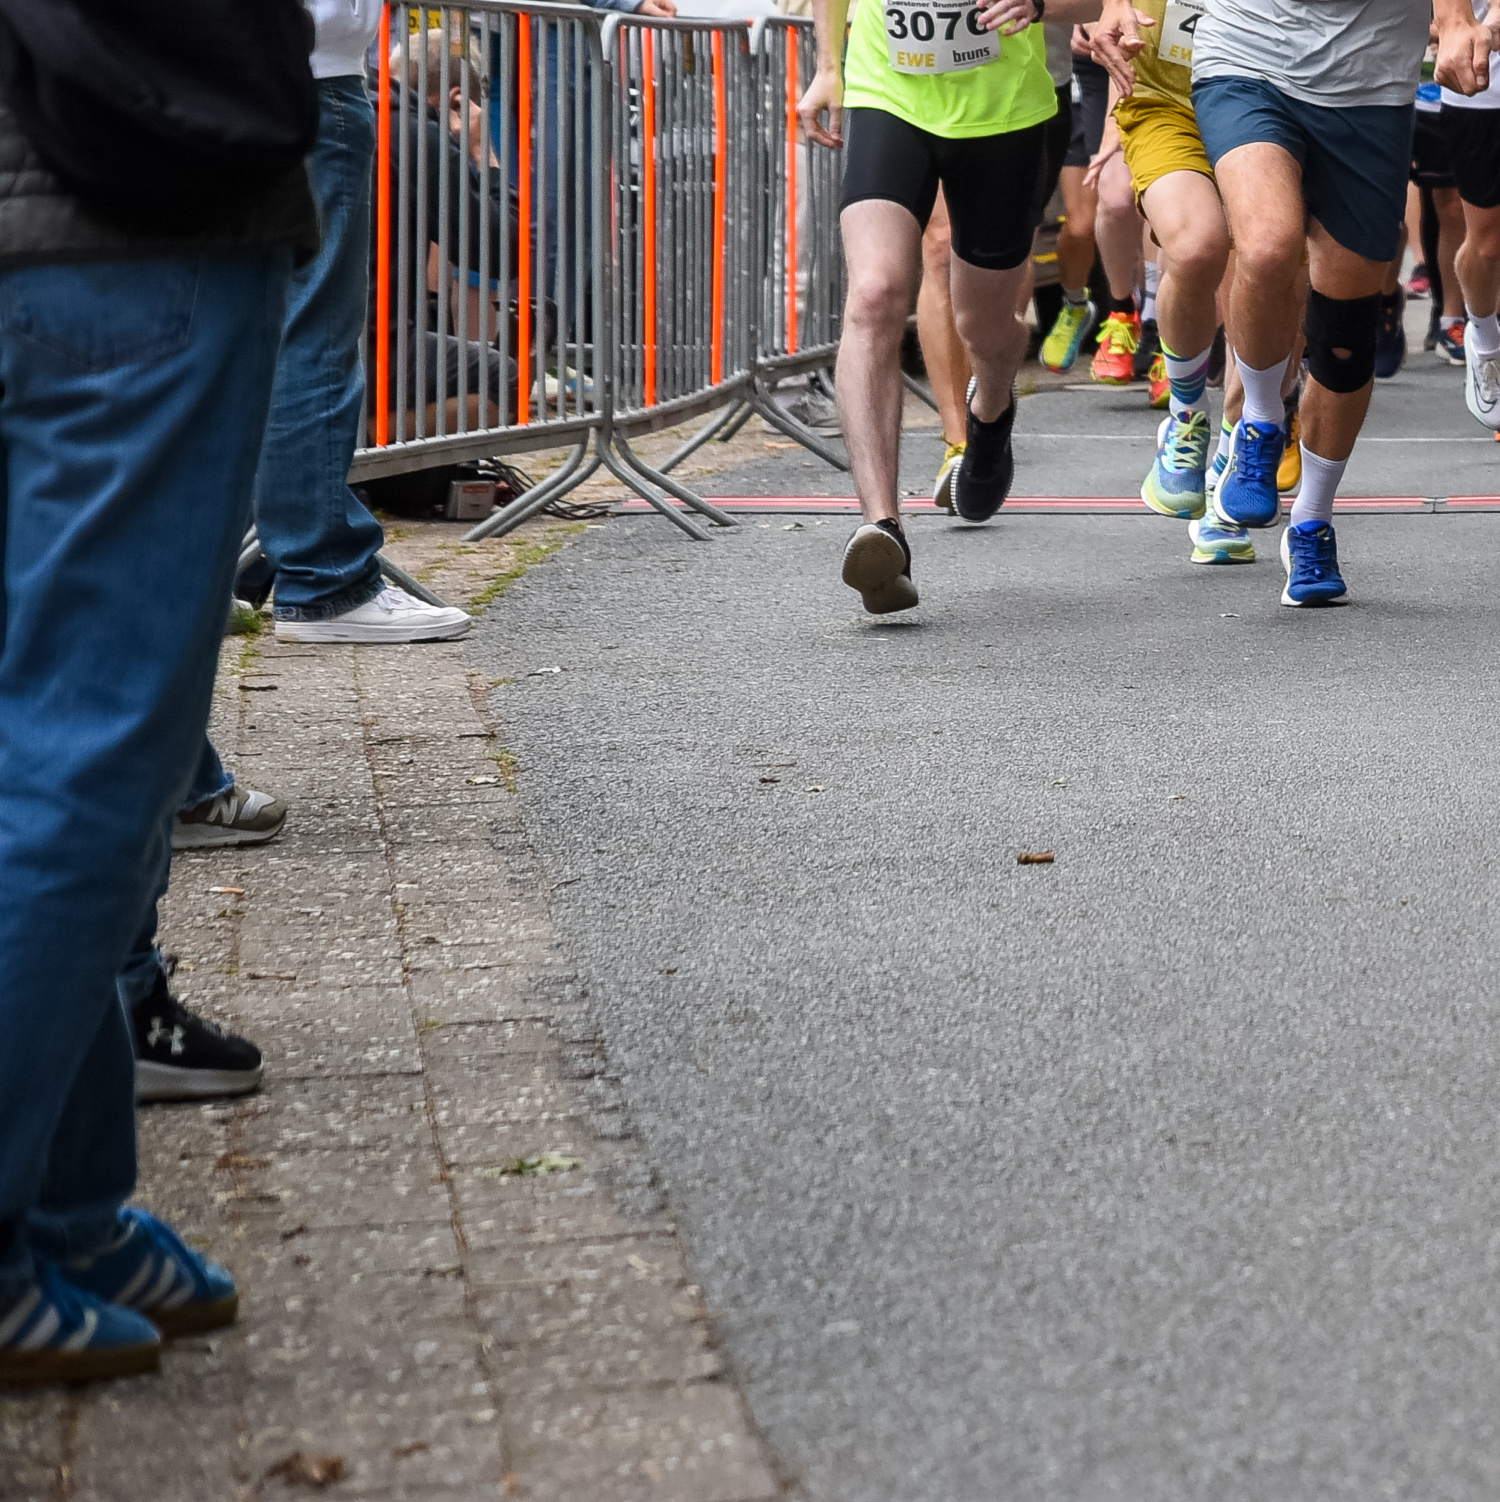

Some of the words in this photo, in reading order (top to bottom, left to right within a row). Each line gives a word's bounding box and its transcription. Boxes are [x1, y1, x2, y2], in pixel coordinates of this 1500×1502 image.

[932, 0, 977, 9] Brunnenla
[897, 51, 936, 68] EWE
[952, 46, 991, 63] bruns
[1169, 44, 1193, 62] EW
